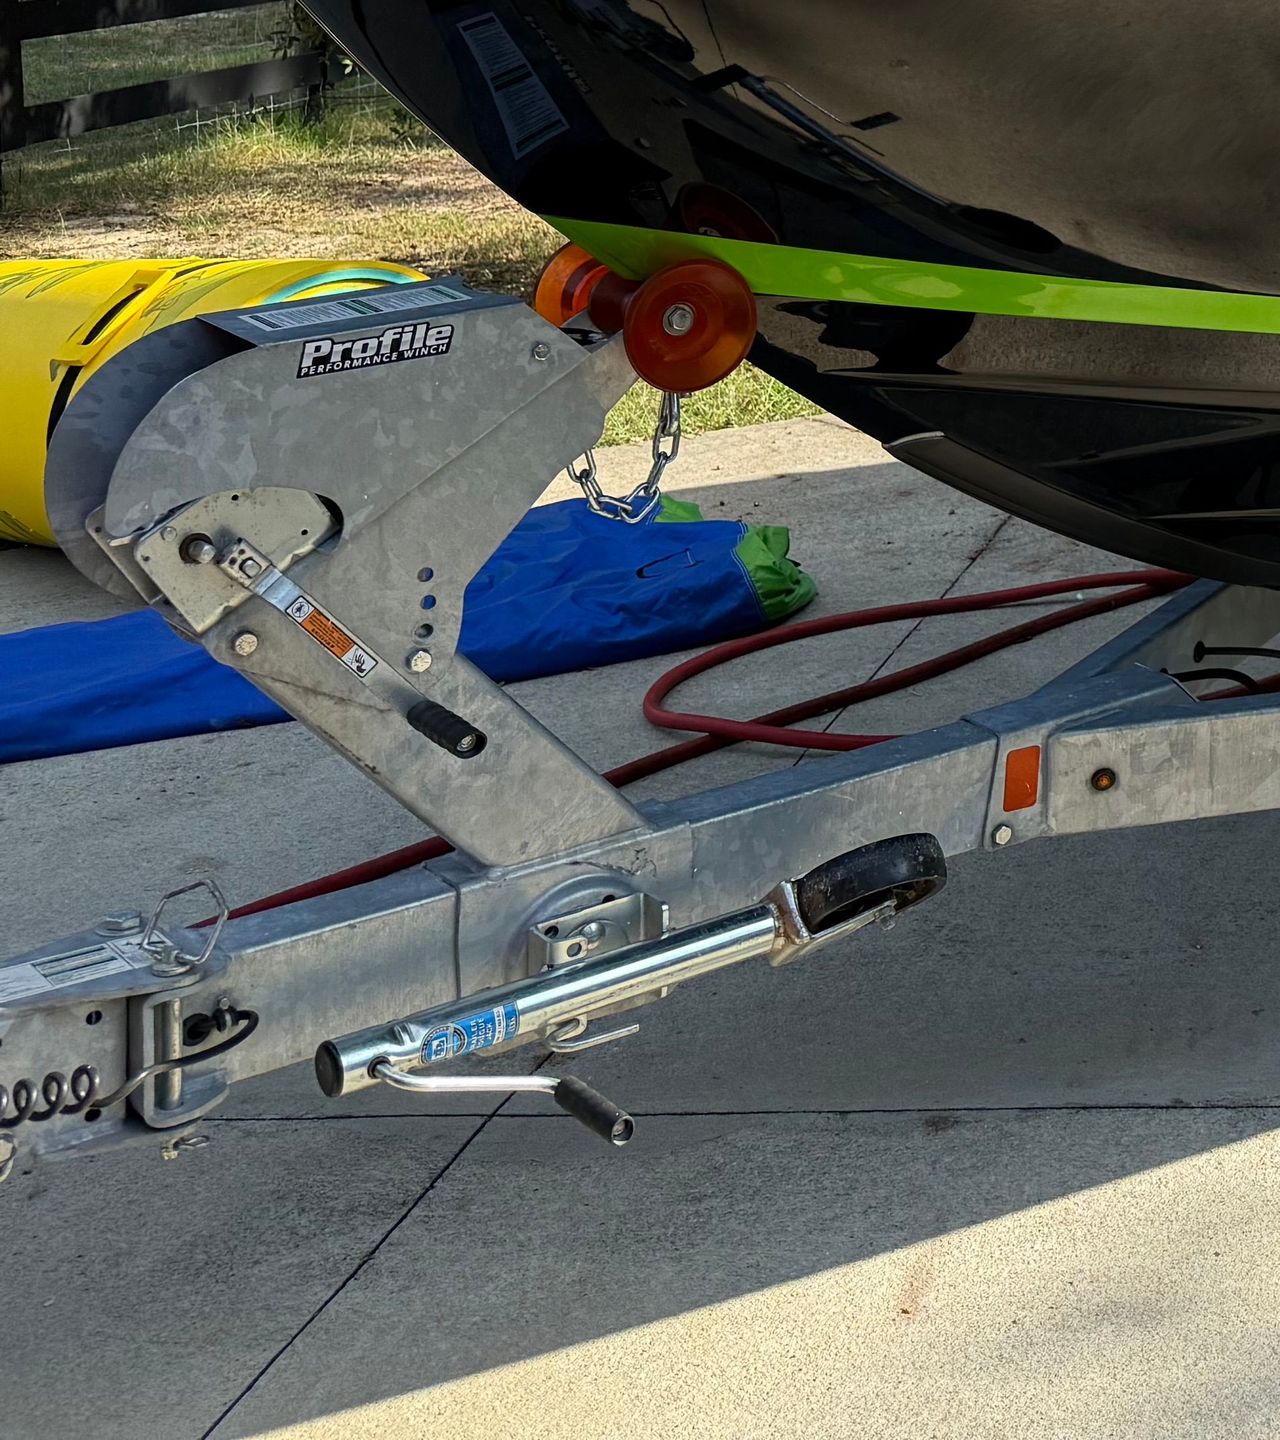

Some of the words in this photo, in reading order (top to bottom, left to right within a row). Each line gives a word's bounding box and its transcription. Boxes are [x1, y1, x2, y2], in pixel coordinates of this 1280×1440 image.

[300, 351, 399, 377] PERFORMANCE
[403, 343, 448, 359] WINCH
[301, 323, 453, 368] Profile
